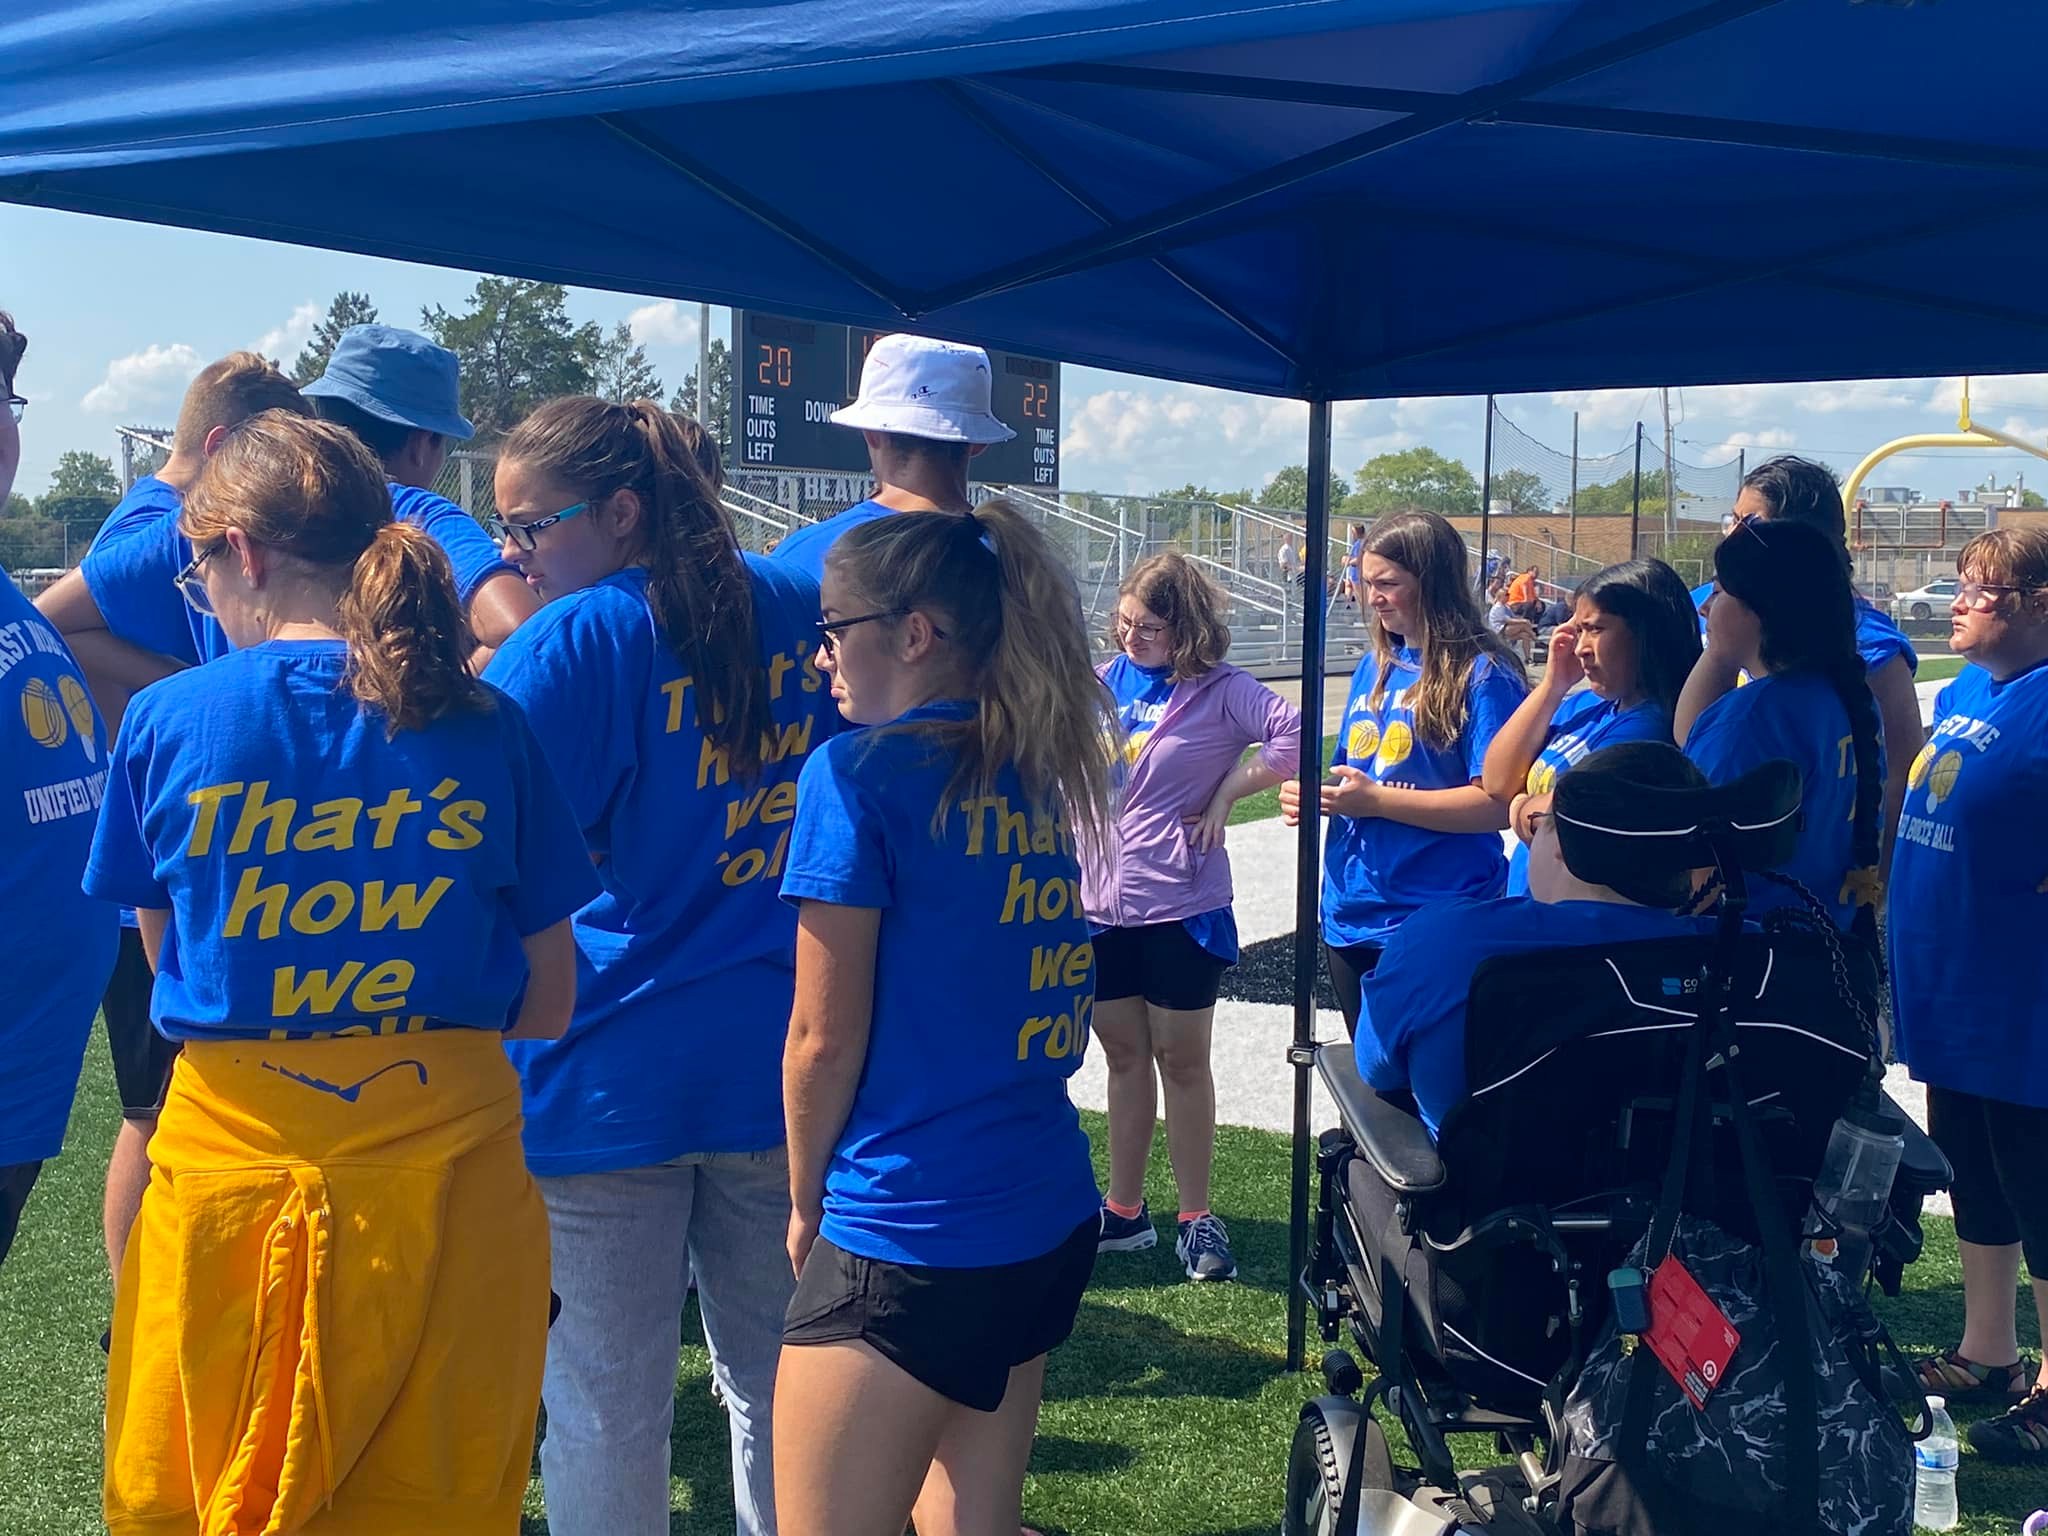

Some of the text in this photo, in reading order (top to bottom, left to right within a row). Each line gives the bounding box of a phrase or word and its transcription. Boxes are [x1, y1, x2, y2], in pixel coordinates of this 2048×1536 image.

[759, 344, 792, 387] 20
[748, 394, 775, 416] TIME
[1022, 382, 1049, 418] 22
[746, 418, 777, 440] OUTS
[747, 441, 775, 462] LEFT
[1034, 427, 1055, 445] TIME
[1033, 447, 1056, 465] OUTS
[1033, 466, 1054, 483] LEFT
[0, 621, 33, 680] AST
[661, 639, 823, 734] Tt's
[696, 713, 814, 790] hw
[23, 777, 91, 824] UNIFIED
[186, 777, 487, 858] That's
[724, 781, 797, 841] we
[222, 865, 455, 940] how
[271, 958, 416, 1018] we
[1029, 941, 1094, 992] we
